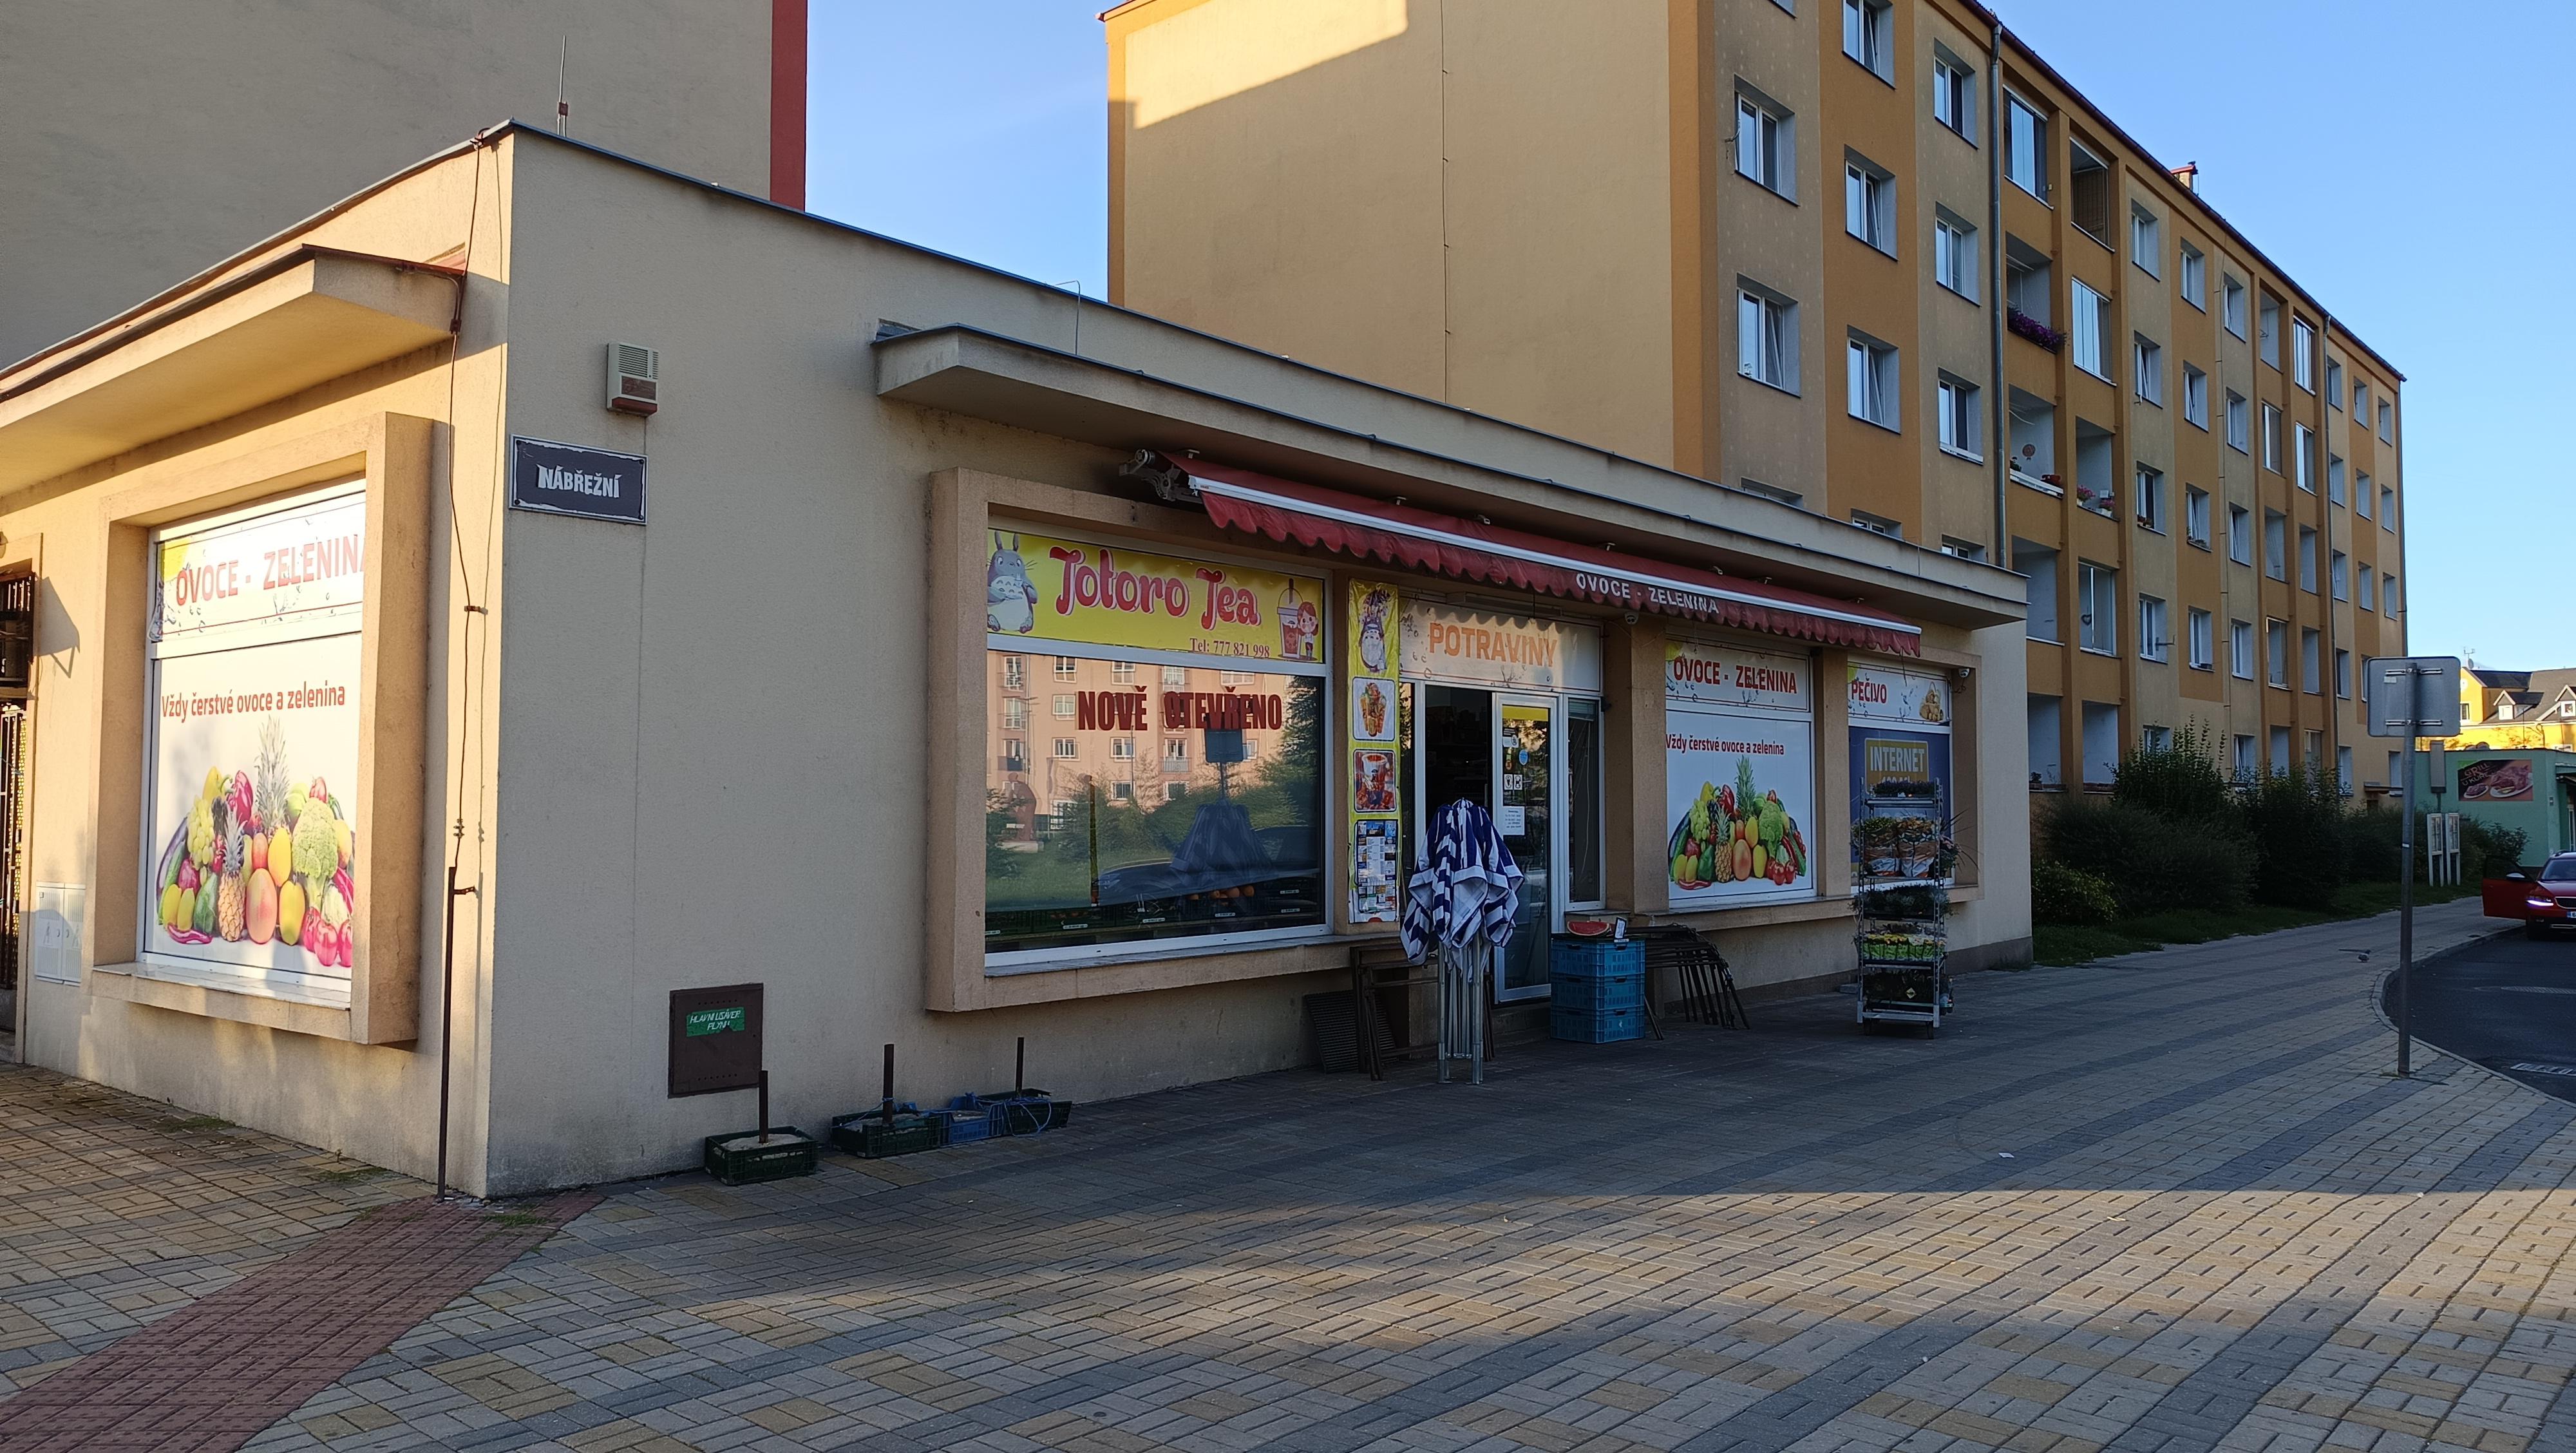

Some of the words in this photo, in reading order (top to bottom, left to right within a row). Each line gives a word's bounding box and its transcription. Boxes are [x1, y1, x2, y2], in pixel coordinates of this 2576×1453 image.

[536, 464, 622, 498] NÁBŘEŽNÍ
[176, 560, 238, 606] OVOCE
[263, 534, 366, 590] ZELENIN
[1049, 546, 1189, 617] Totoro
[1196, 567, 1262, 631] Tea
[1576, 573, 1631, 599] OVOCE
[1648, 586, 1719, 614] ZELENINA
[1189, 638, 1210, 652] Tel:
[1213, 640, 1231, 654] 777
[1233, 642, 1249, 656] 821
[1253, 644, 1270, 658] 998
[1429, 622, 1557, 667] POTRAVINY
[1673, 656, 1721, 685] OVOCE
[1736, 665, 1797, 694] ZELENINA
[162, 692, 188, 723] Vždy
[191, 689, 233, 716] čerstvé
[237, 692, 272, 713] ovoce
[276, 691, 283, 710] a
[287, 680, 345, 709] zelenina
[1078, 685, 1148, 731] NOVĚ
[1163, 686, 1283, 730] OTEVŘENO
[1666, 733, 1687, 754] Vždy
[1689, 735, 1719, 752] čerstvé
[1721, 740, 1745, 753] ovoce
[1746, 743, 1751, 754] a
[1752, 739, 1785, 755] zelenina
[1870, 746, 1924, 772] INTERNET
[2464, 763, 2490, 777] GRILL
